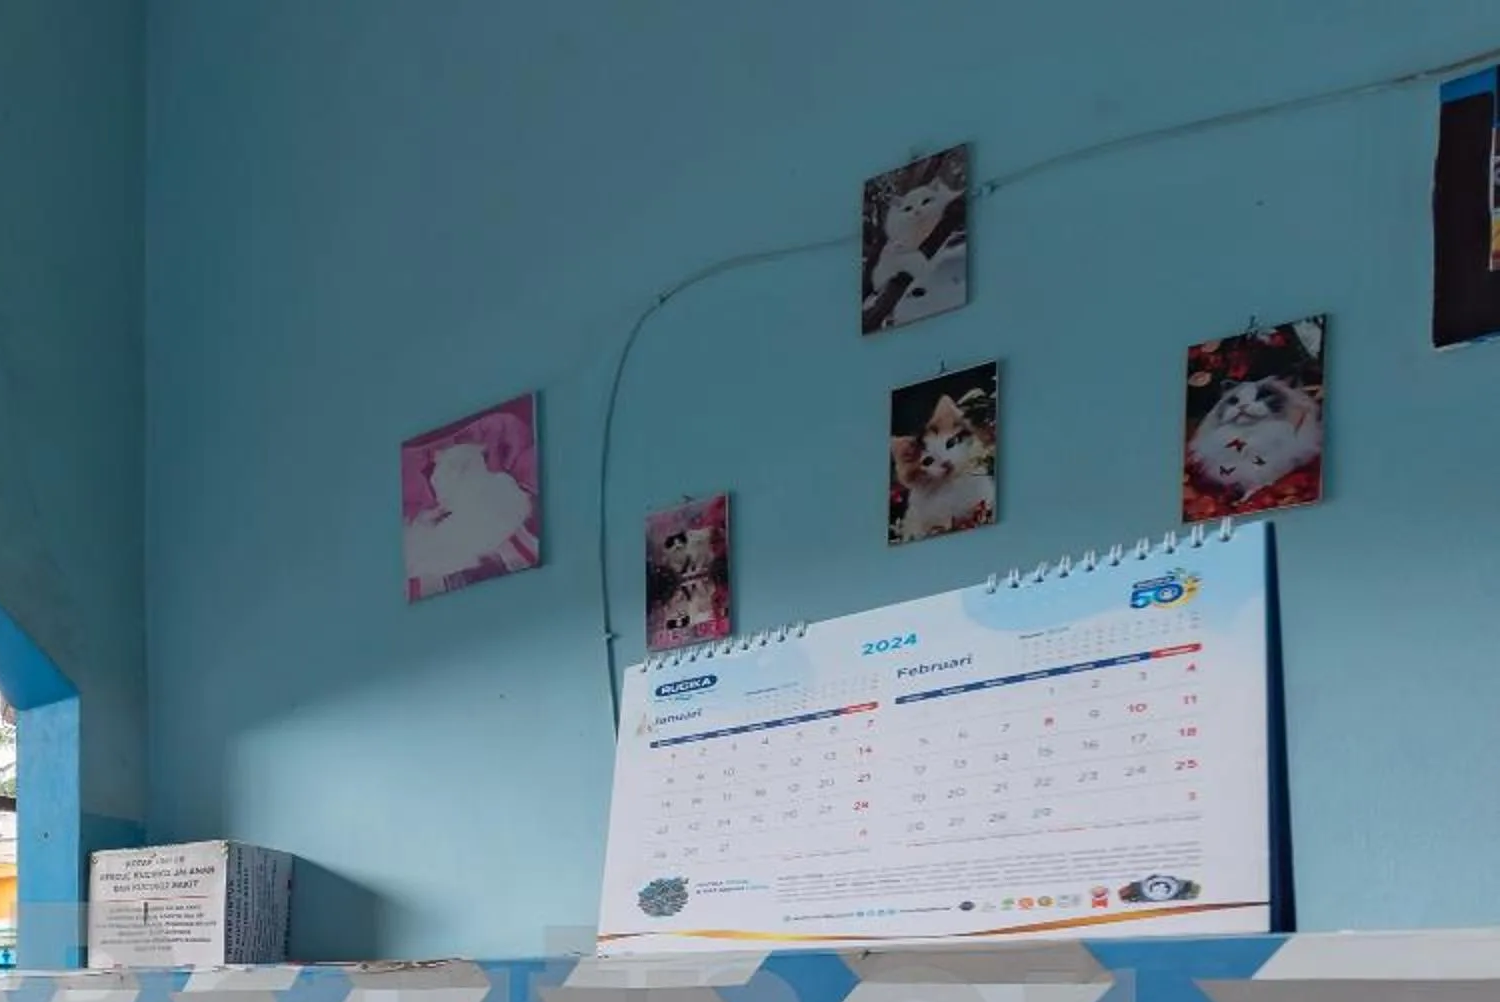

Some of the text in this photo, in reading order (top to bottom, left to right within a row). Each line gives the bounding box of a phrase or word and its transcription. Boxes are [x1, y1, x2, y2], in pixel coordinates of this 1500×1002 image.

[861, 633, 917, 656] 2024
[896, 653, 973, 679] Februari
[653, 707, 703, 726] Januari
